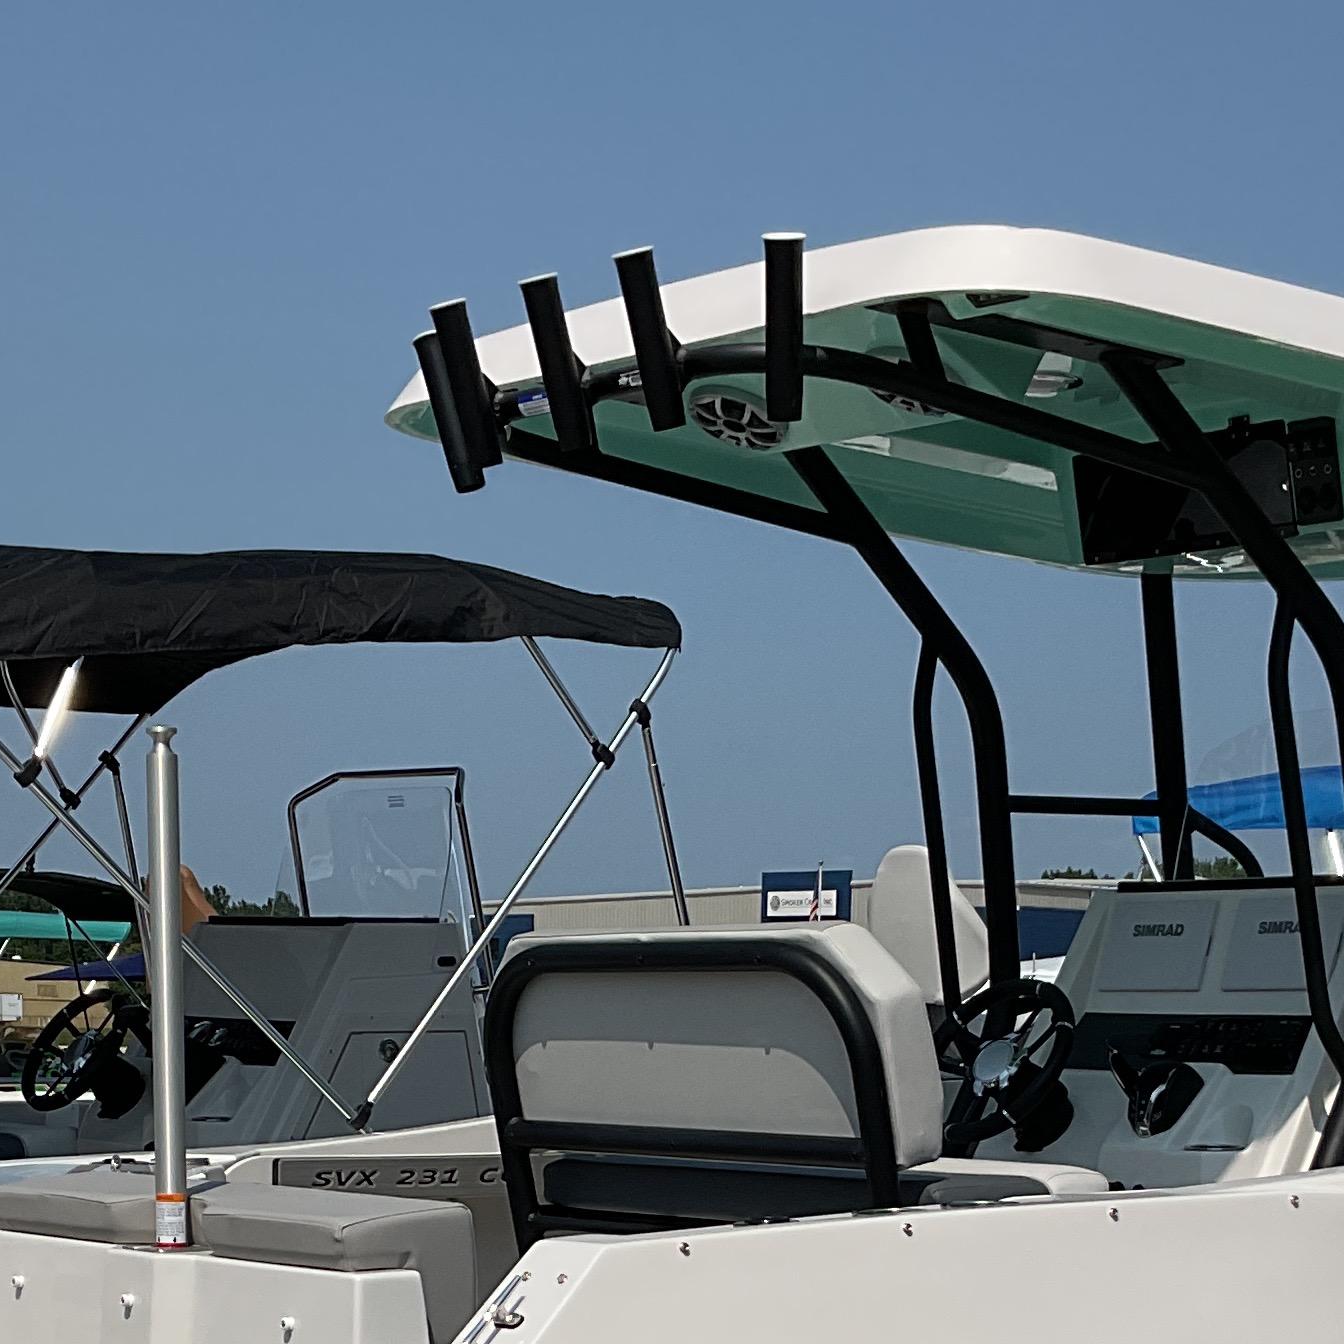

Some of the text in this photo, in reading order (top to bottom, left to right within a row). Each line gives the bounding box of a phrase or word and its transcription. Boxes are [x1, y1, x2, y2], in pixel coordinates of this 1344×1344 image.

[1132, 924, 1185, 937] SIMRAD
[1258, 921, 1301, 935] SIMRA
[312, 1167, 506, 1187] SVX 231 C
